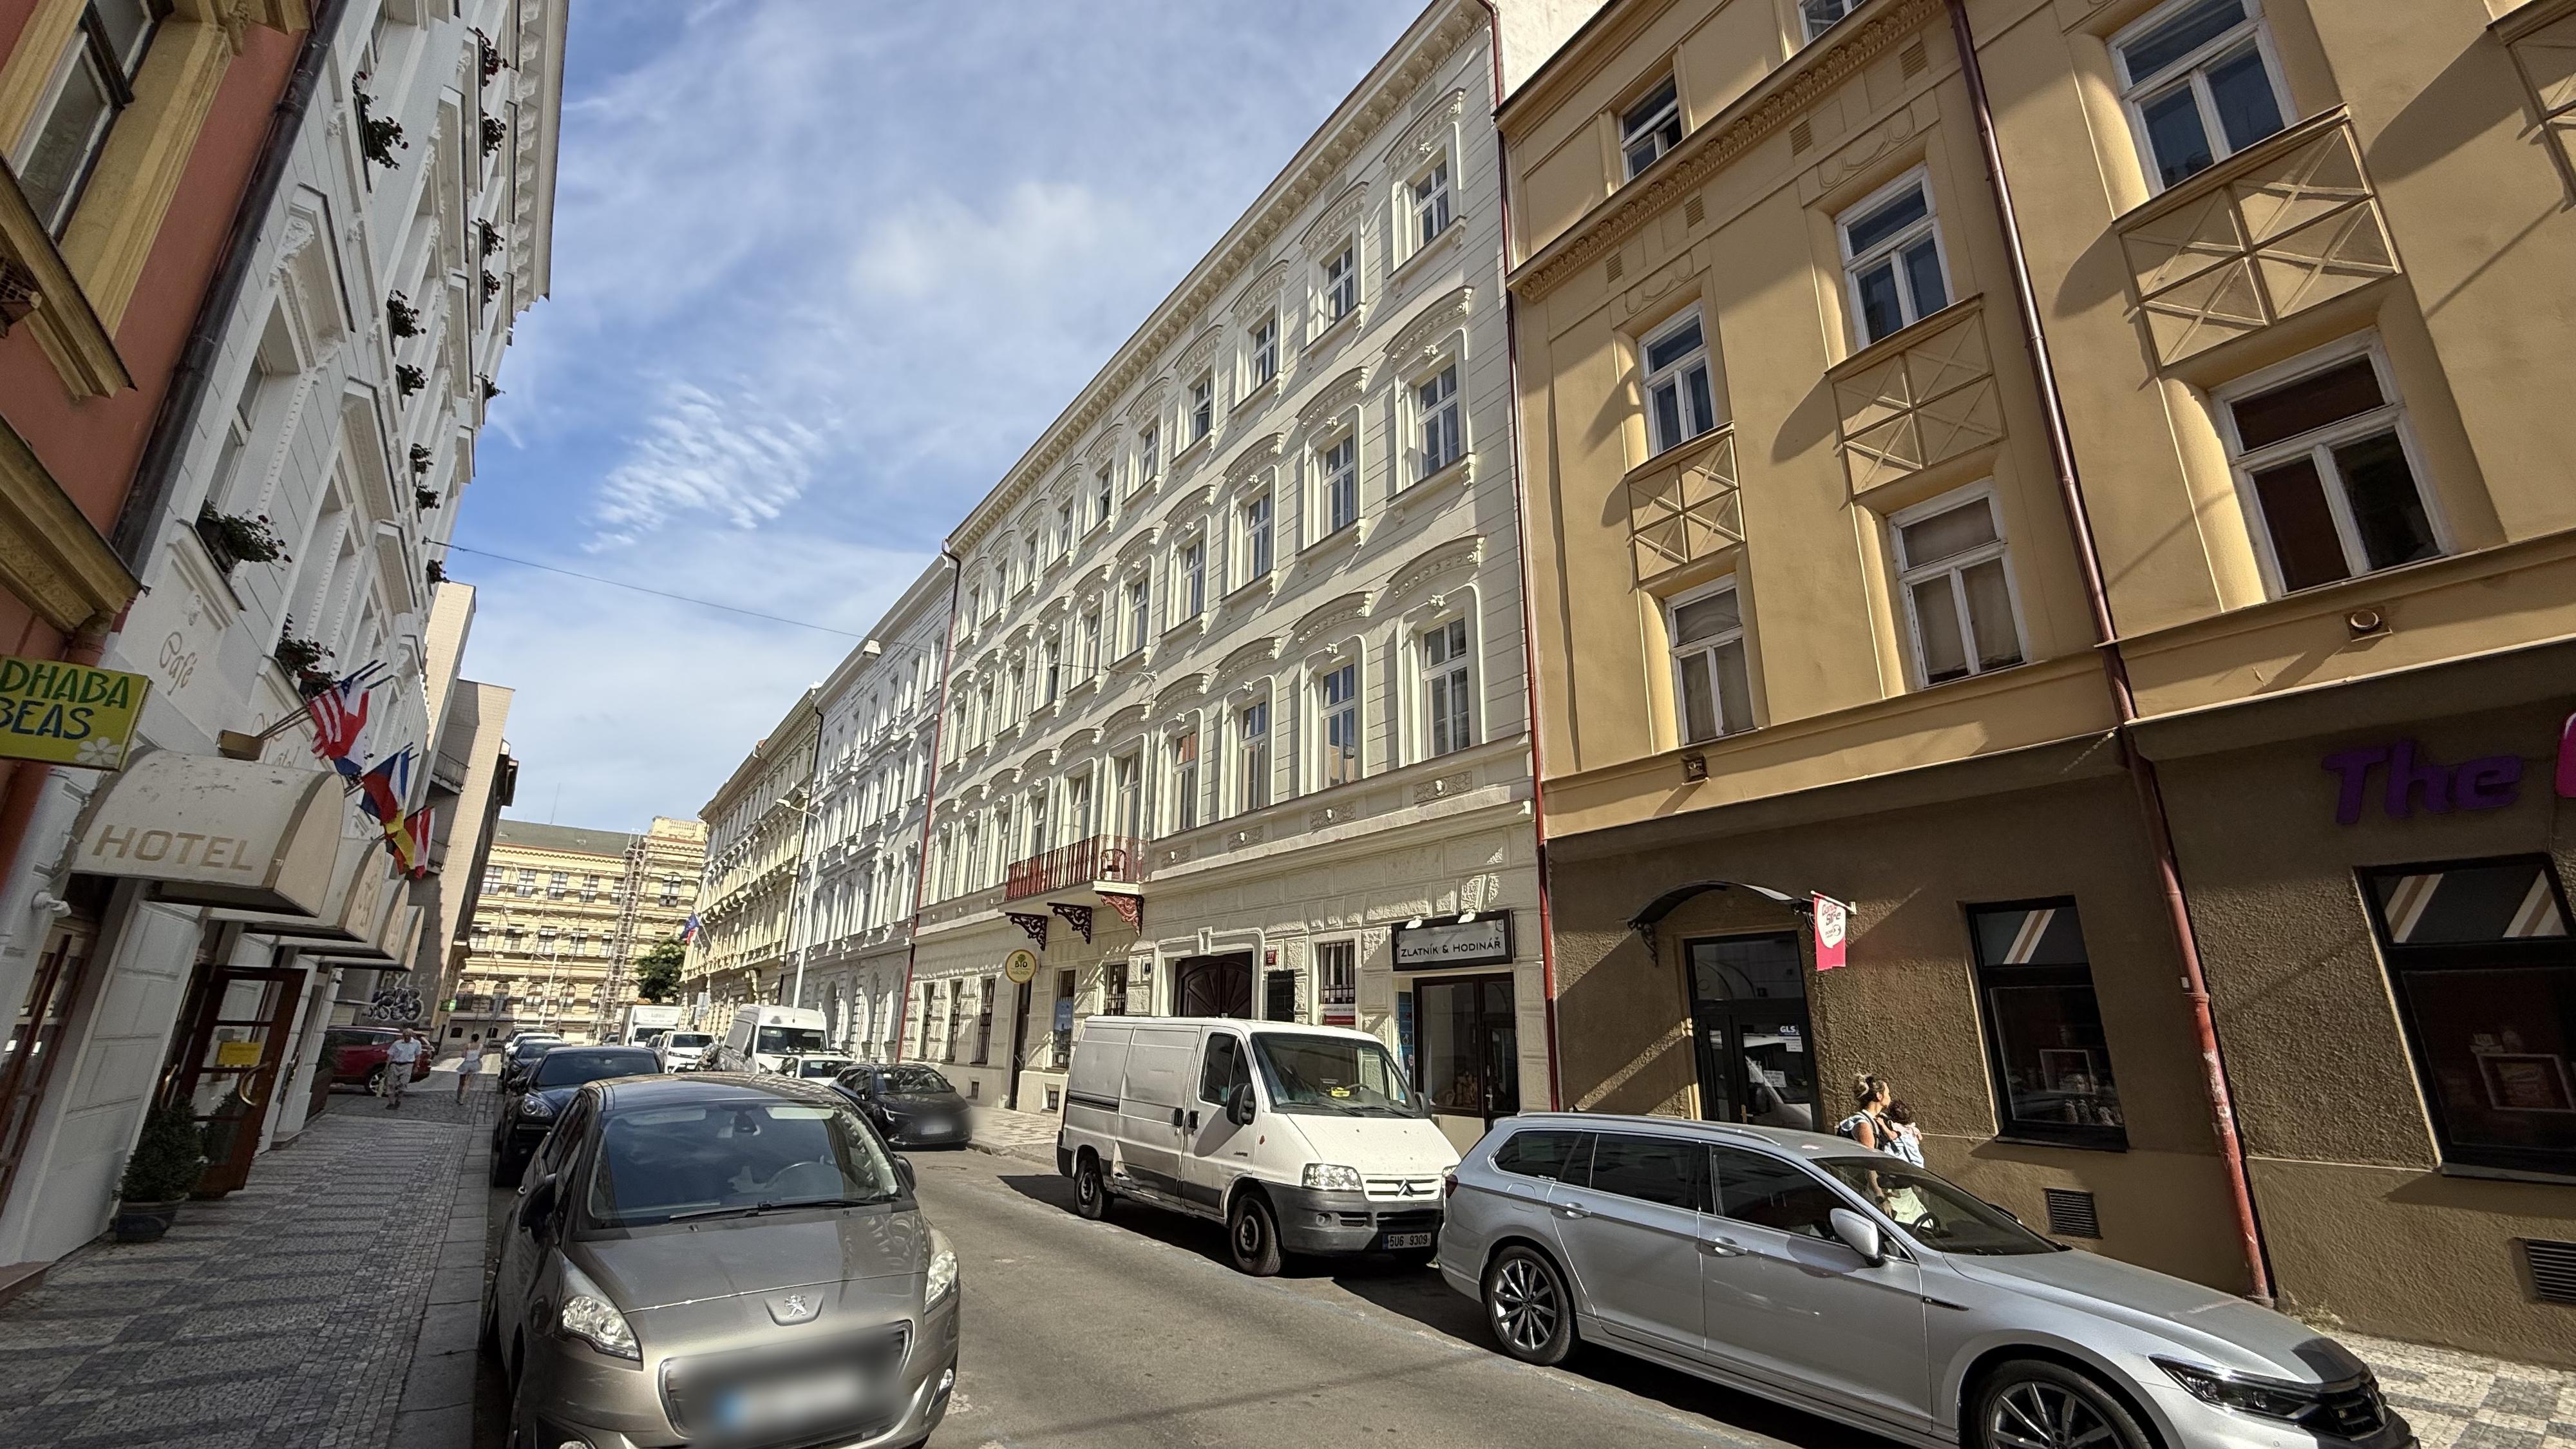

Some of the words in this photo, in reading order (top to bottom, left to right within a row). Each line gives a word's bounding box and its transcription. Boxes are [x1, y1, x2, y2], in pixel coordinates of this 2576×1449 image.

[0, 659, 130, 709] DHABA
[2321, 740, 2523, 826] The
[92, 824, 254, 871] HOTEL
[1400, 943, 1439, 958] ZLATNÍK
[1442, 945, 1449, 954] &
[1453, 936, 1501, 953] HODINÁŘ
[1390, 1235, 1404, 1247] 5U6
[1409, 1234, 1428, 1246] 9309
